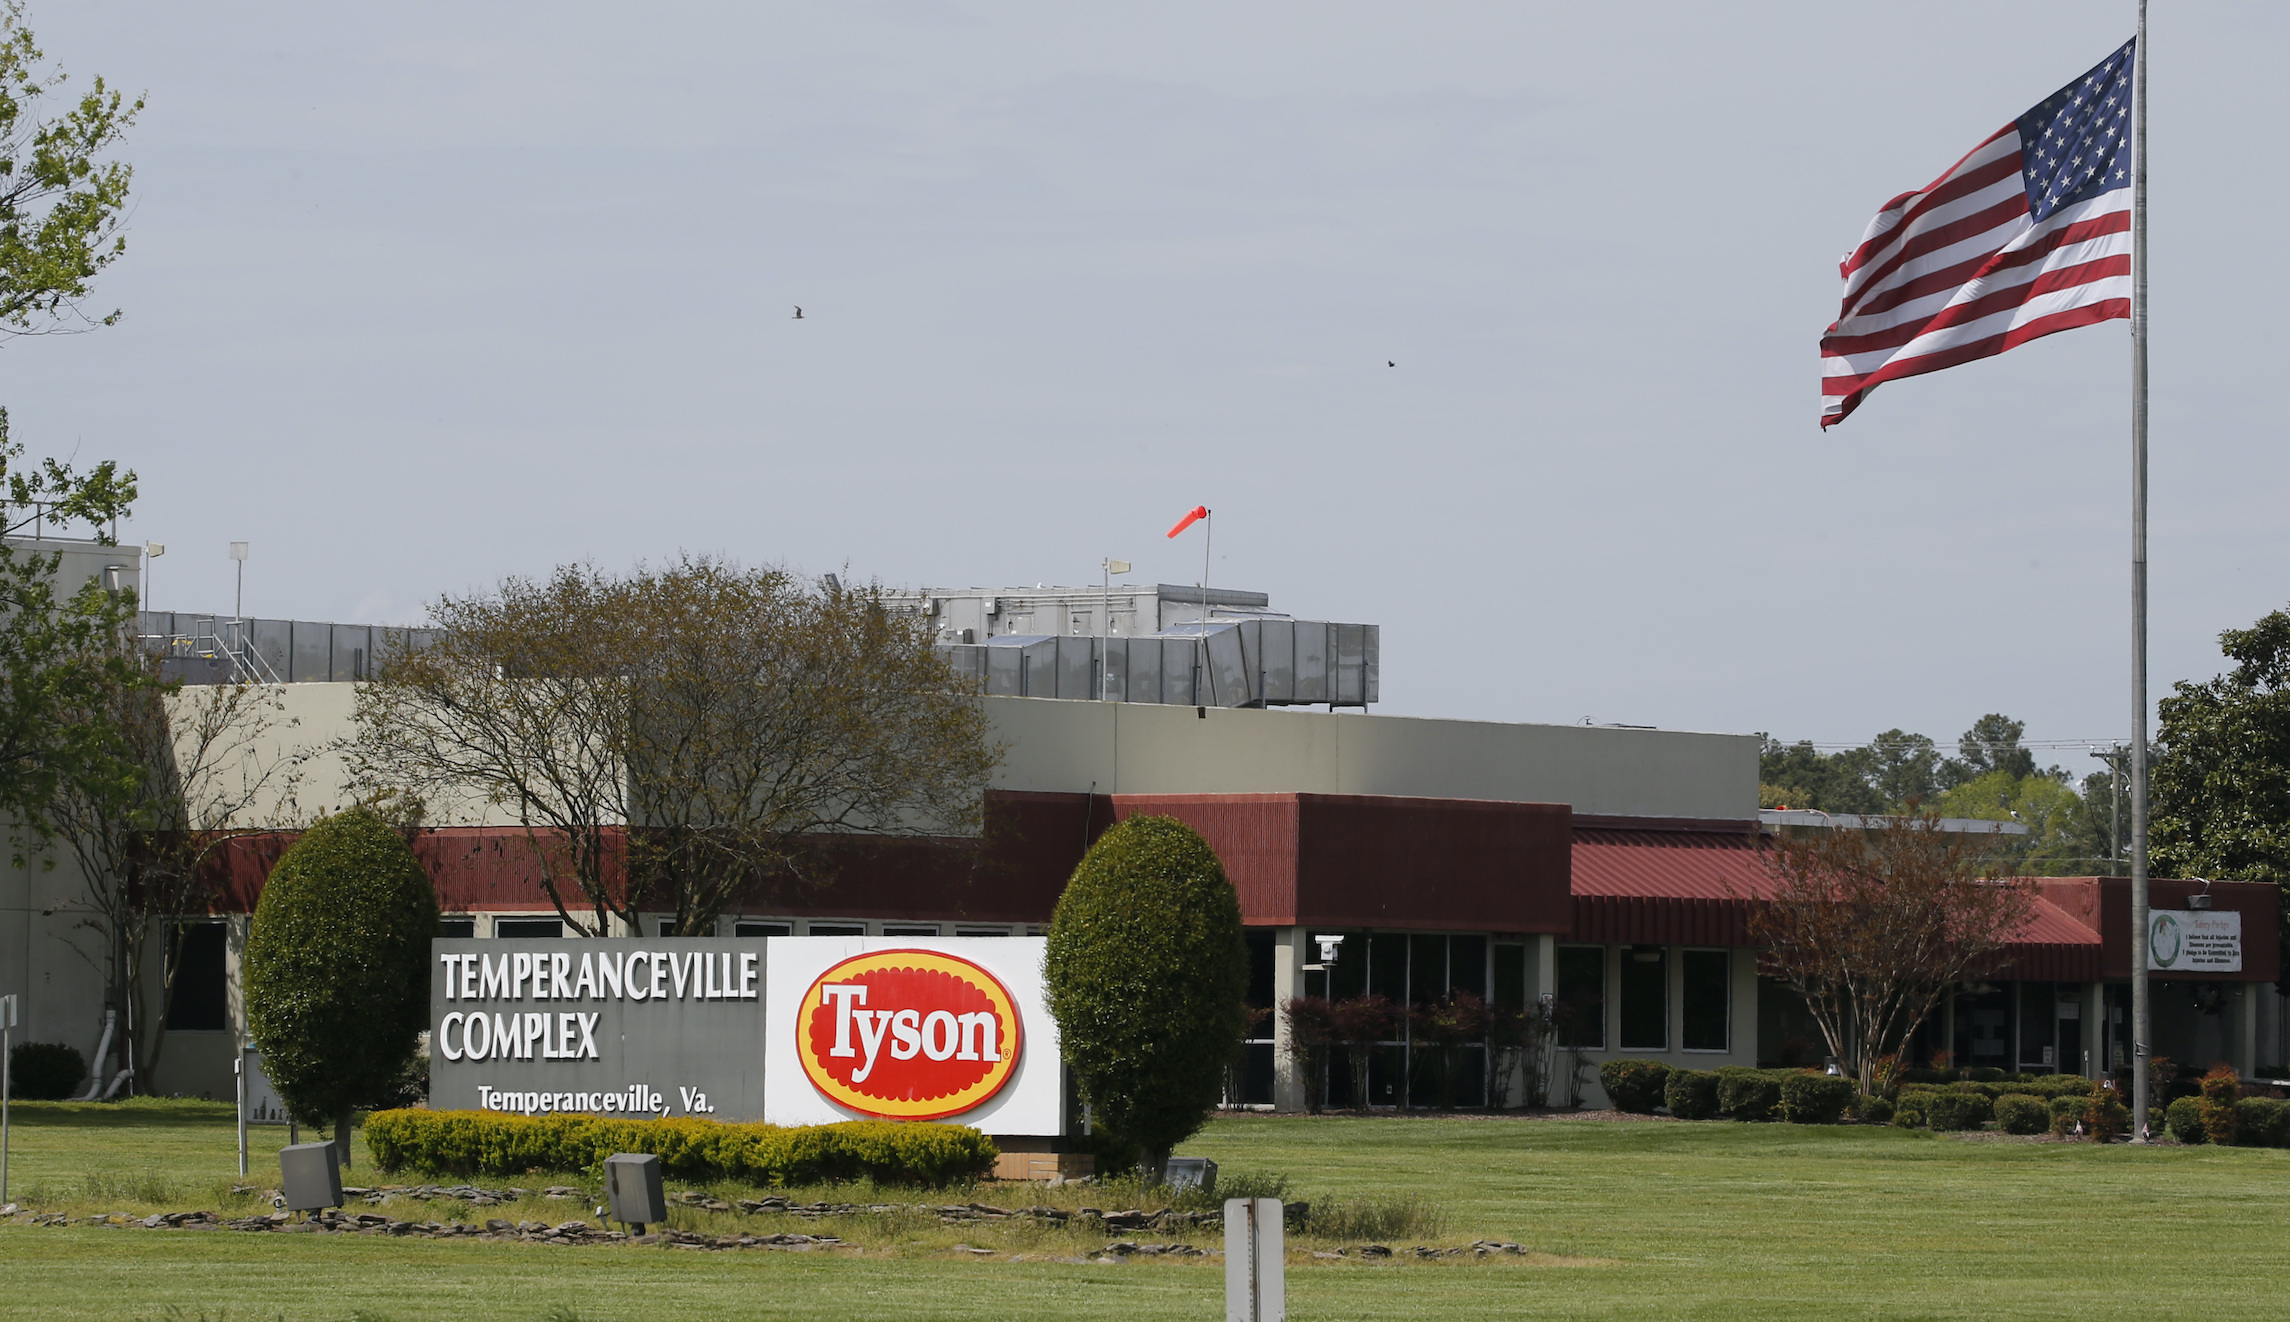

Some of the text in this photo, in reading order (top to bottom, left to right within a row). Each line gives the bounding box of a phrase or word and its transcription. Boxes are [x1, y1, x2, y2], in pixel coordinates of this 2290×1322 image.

[2211, 920, 2230, 931] Pledge
[440, 950, 757, 1000] TEMPERANCEVILLE
[439, 1011, 599, 1060] COMPLEX
[822, 983, 1001, 1082] Tyson
[477, 1083, 714, 1117] Temperanceville, Va.
